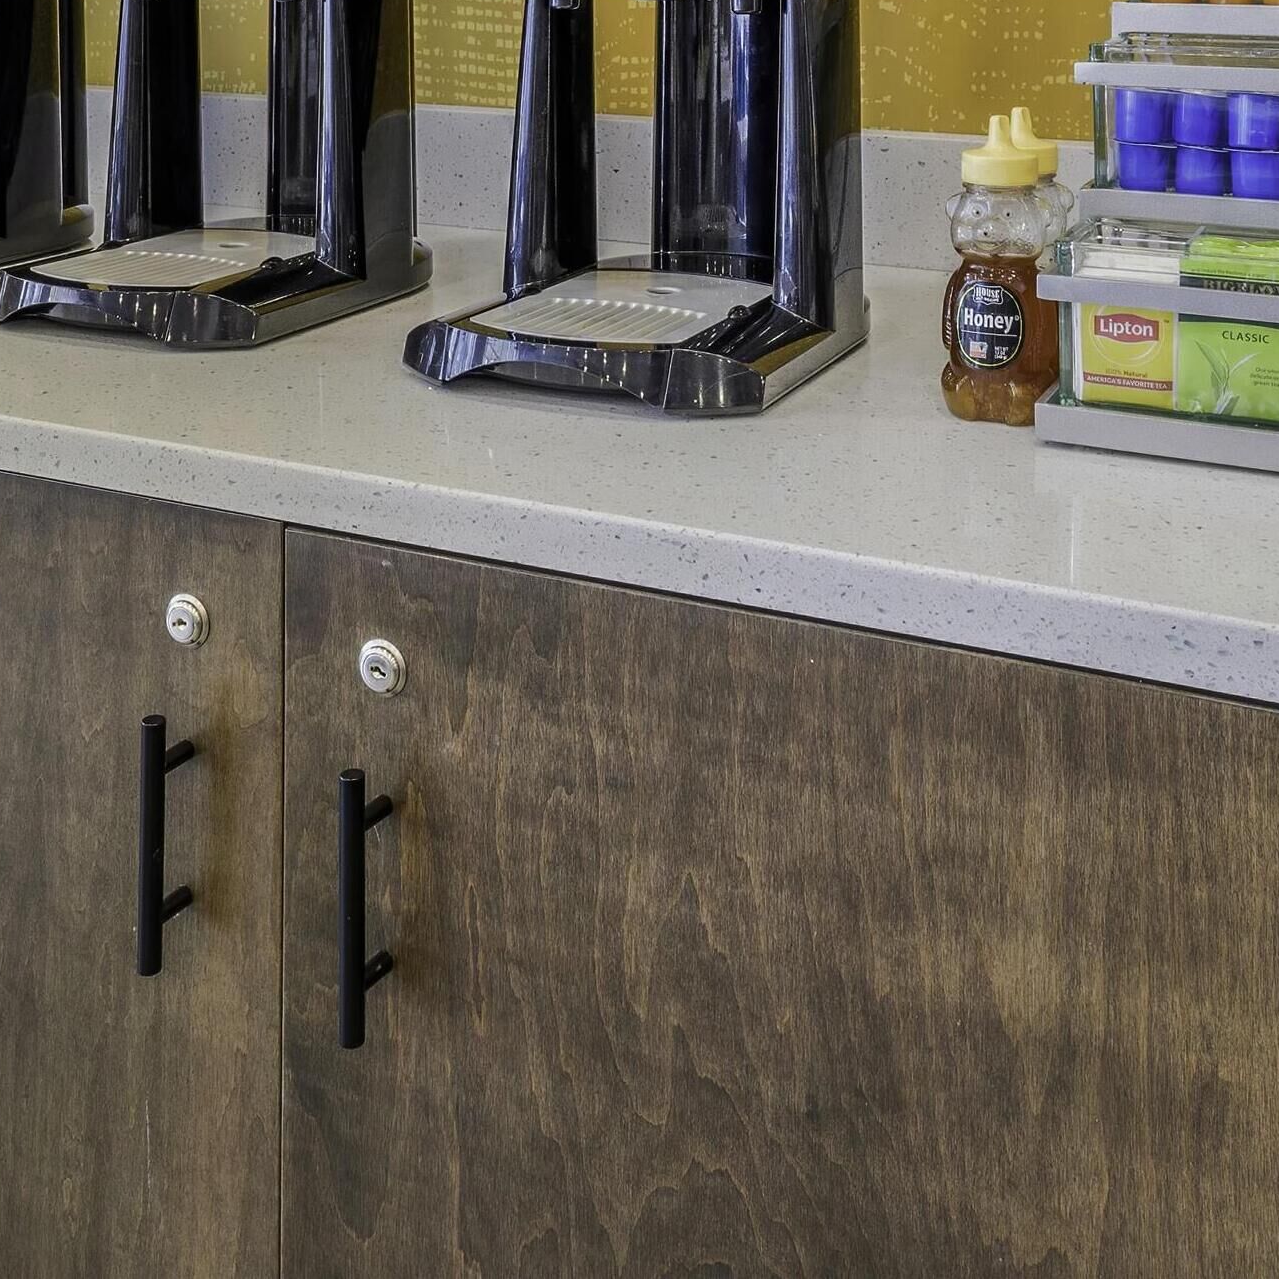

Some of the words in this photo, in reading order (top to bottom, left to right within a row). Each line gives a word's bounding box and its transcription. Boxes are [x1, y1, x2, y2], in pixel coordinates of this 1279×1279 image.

[975, 286, 1000, 299] HOUSE
[964, 307, 1014, 334] Honey
[1100, 318, 1153, 337] Lipton
[1222, 330, 1270, 344] CLASSIC
[1087, 375, 1121, 385] AMERICA'S
[1122, 378, 1153, 389] FAVORITE
